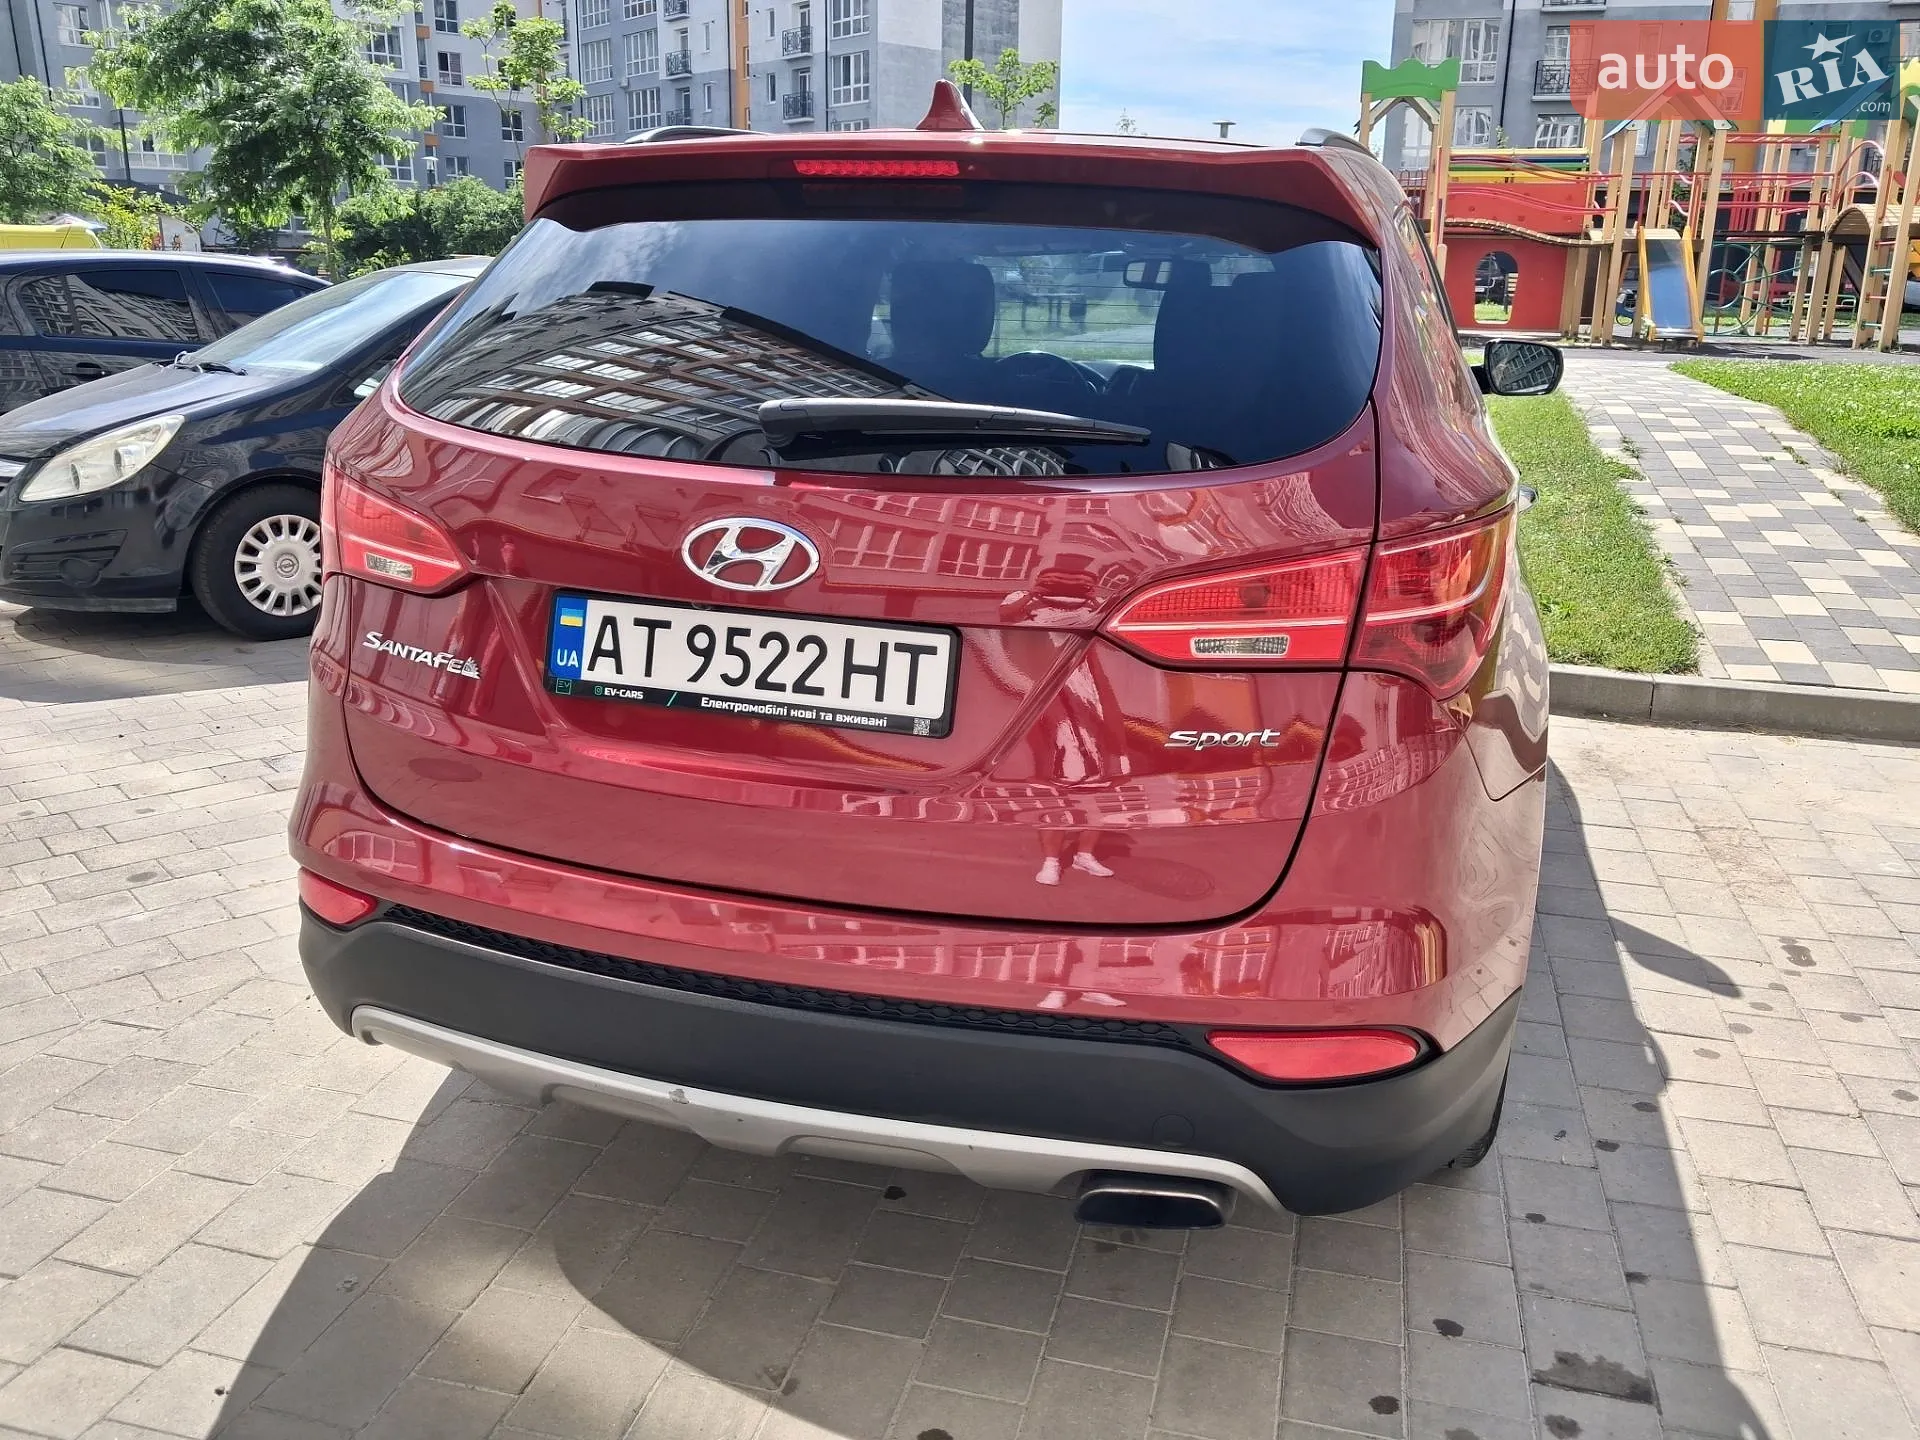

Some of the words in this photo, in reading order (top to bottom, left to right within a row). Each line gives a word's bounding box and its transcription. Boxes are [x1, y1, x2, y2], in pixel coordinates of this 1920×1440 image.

[556, 648, 579, 668] UA
[587, 615, 672, 677] AT
[686, 624, 829, 697] 9522
[841, 638, 938, 706] HT
[604, 687, 644, 700] EV-CARS
[701, 697, 787, 716] Електромобілі
[790, 707, 816, 719] нові
[819, 711, 832, 721] та
[836, 713, 888, 728] вживані
[1164, 728, 1280, 751] Sport
